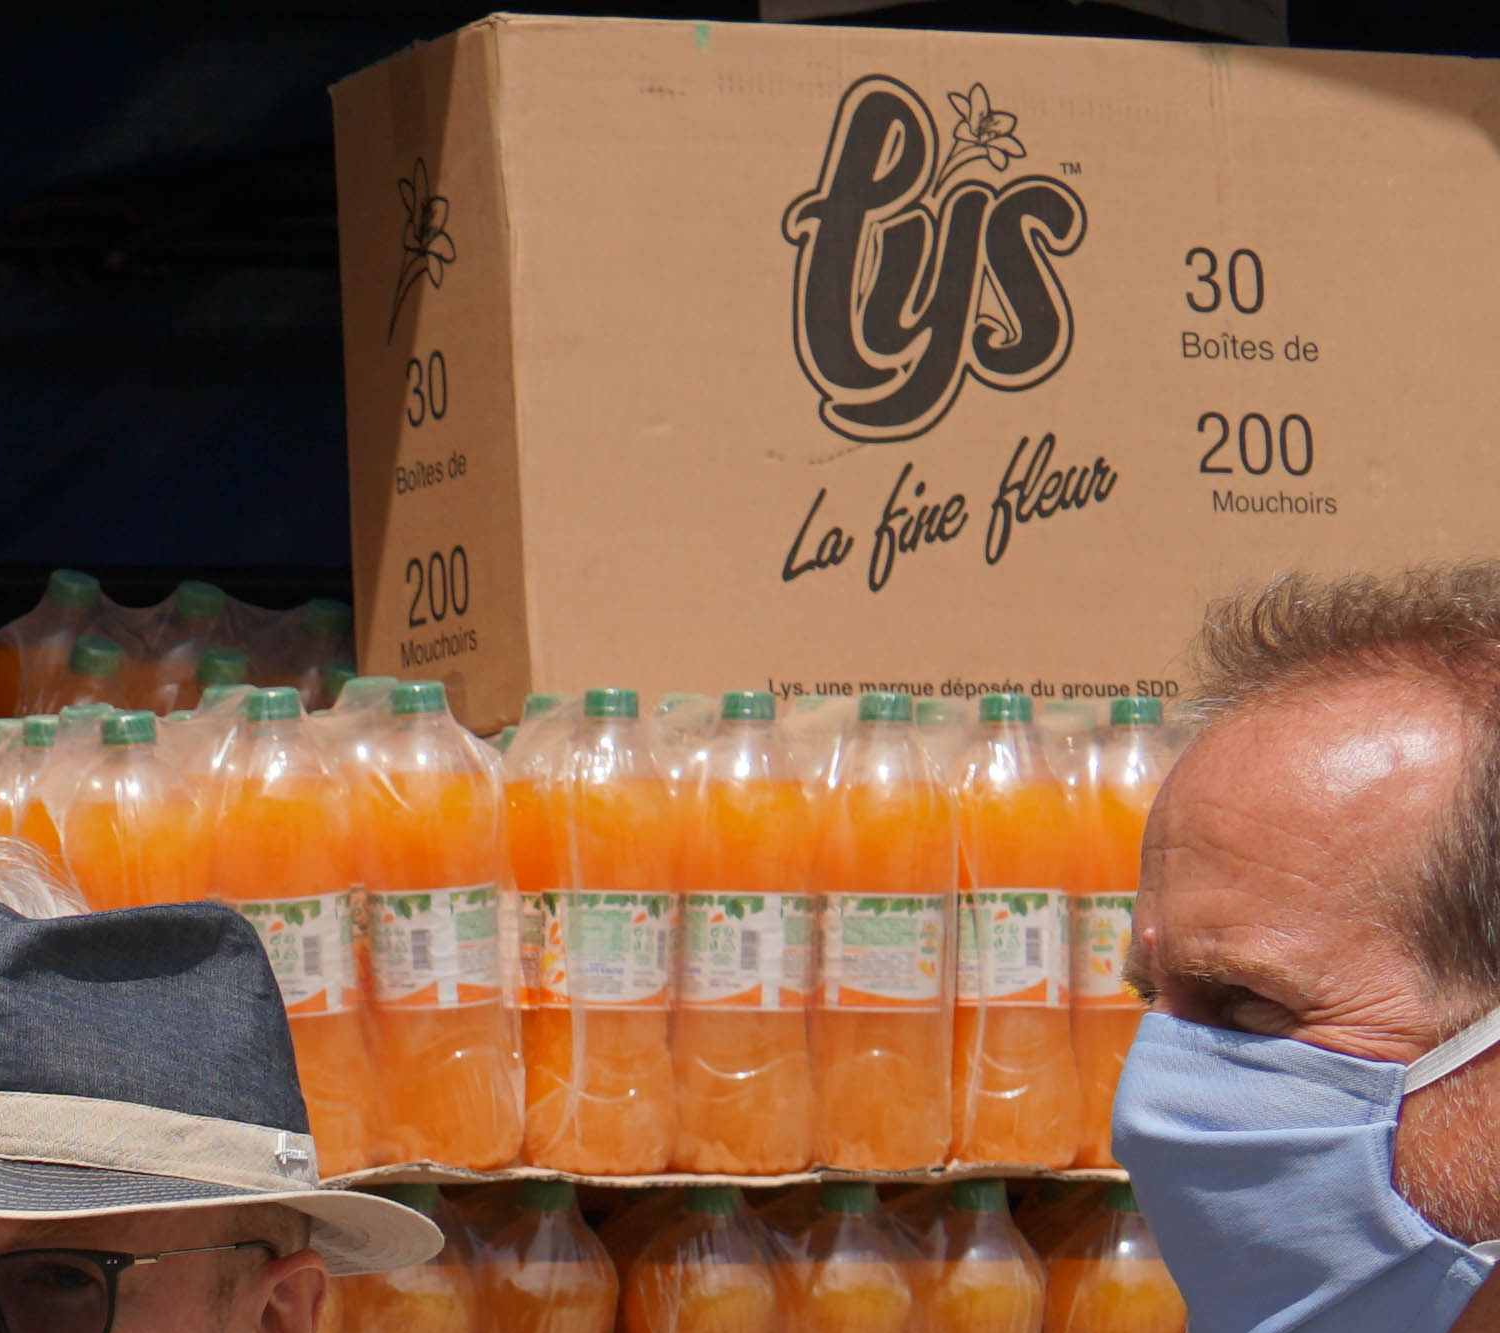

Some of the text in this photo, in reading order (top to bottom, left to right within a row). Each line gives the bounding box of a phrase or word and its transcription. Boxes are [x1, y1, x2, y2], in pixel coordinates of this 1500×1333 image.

[1186, 248, 1264, 315] 30
[1182, 330, 1319, 364] Boîtes de
[406, 350, 447, 427] 30
[1197, 412, 1313, 477] 200
[395, 452, 468, 496] Boîtes de
[782, 434, 1119, 591] La fine fleur
[1212, 491, 1337, 517] Mouchoirs
[405, 545, 470, 629] 200
[399, 624, 477, 669] Mouchoirs
[816, 681, 853, 697] une
[941, 678, 1024, 697] déposée
[1032, 679, 1054, 697] du
[1061, 681, 1130, 700] groupe
[1136, 680, 1179, 697] SDD
